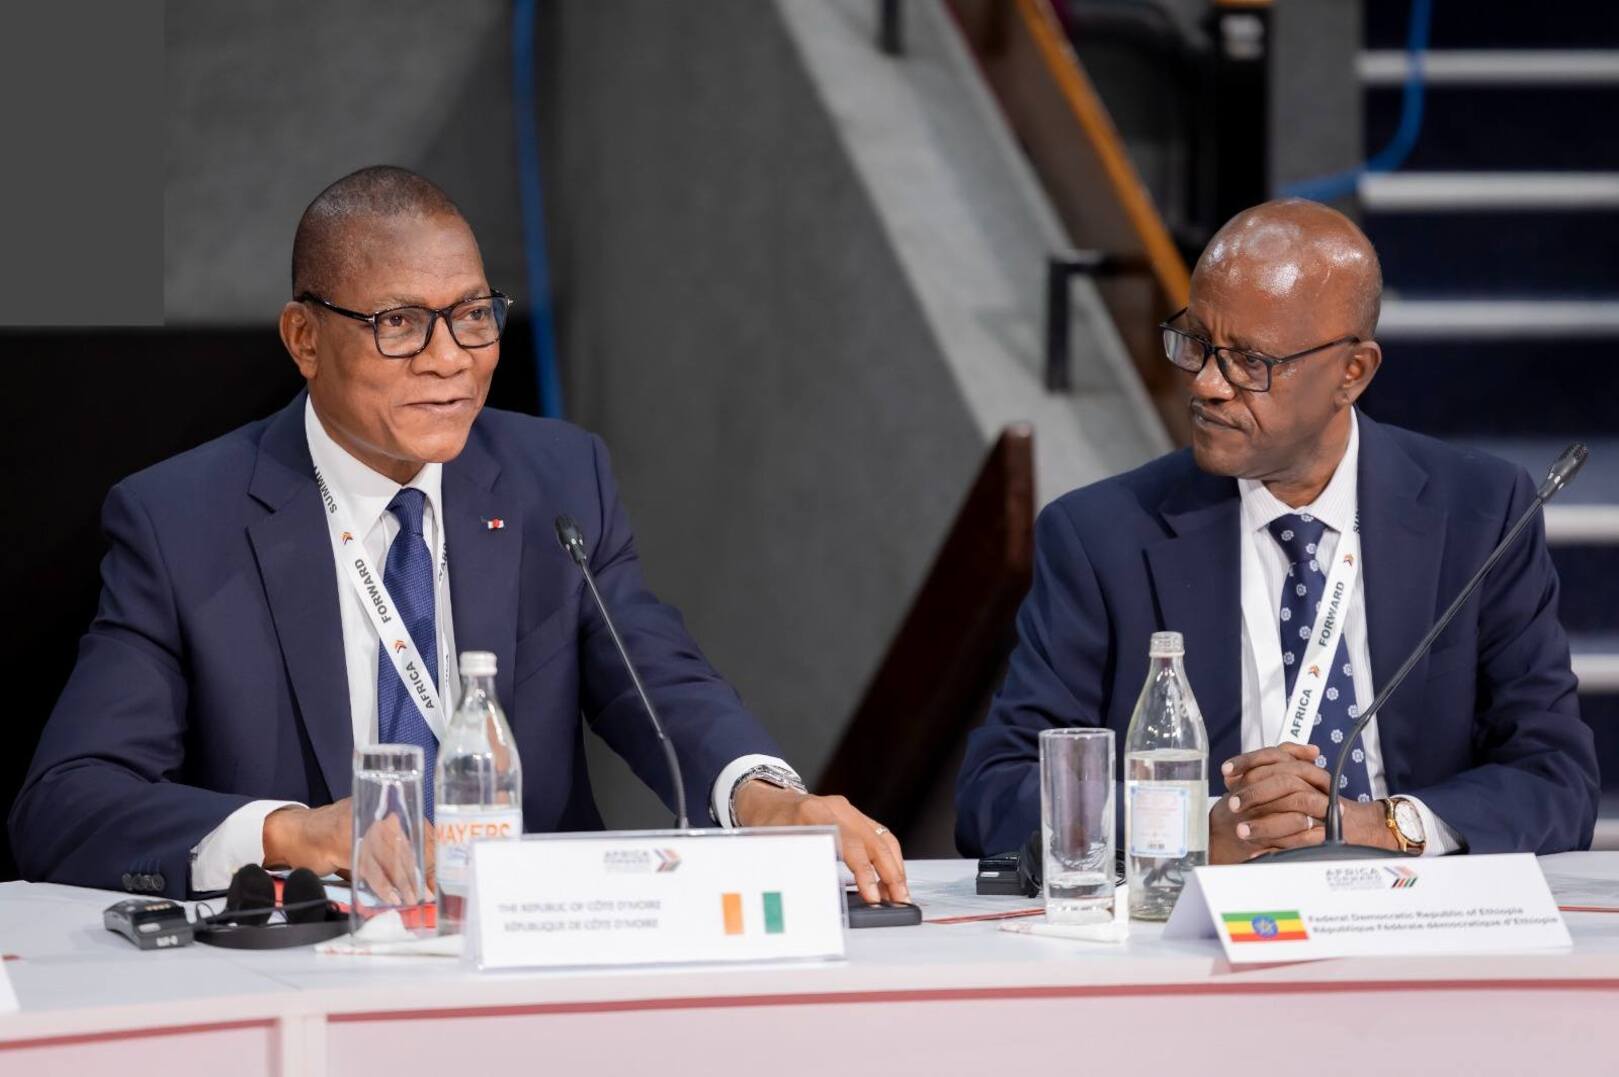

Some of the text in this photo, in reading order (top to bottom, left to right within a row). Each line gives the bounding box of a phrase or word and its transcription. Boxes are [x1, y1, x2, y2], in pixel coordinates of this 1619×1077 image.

[354, 558, 391, 624] FORWARD
[406, 660, 435, 709] AFRICA
[1290, 580, 1345, 738] AFRICA FORWARD
[1325, 866, 1379, 876] AFRICA
